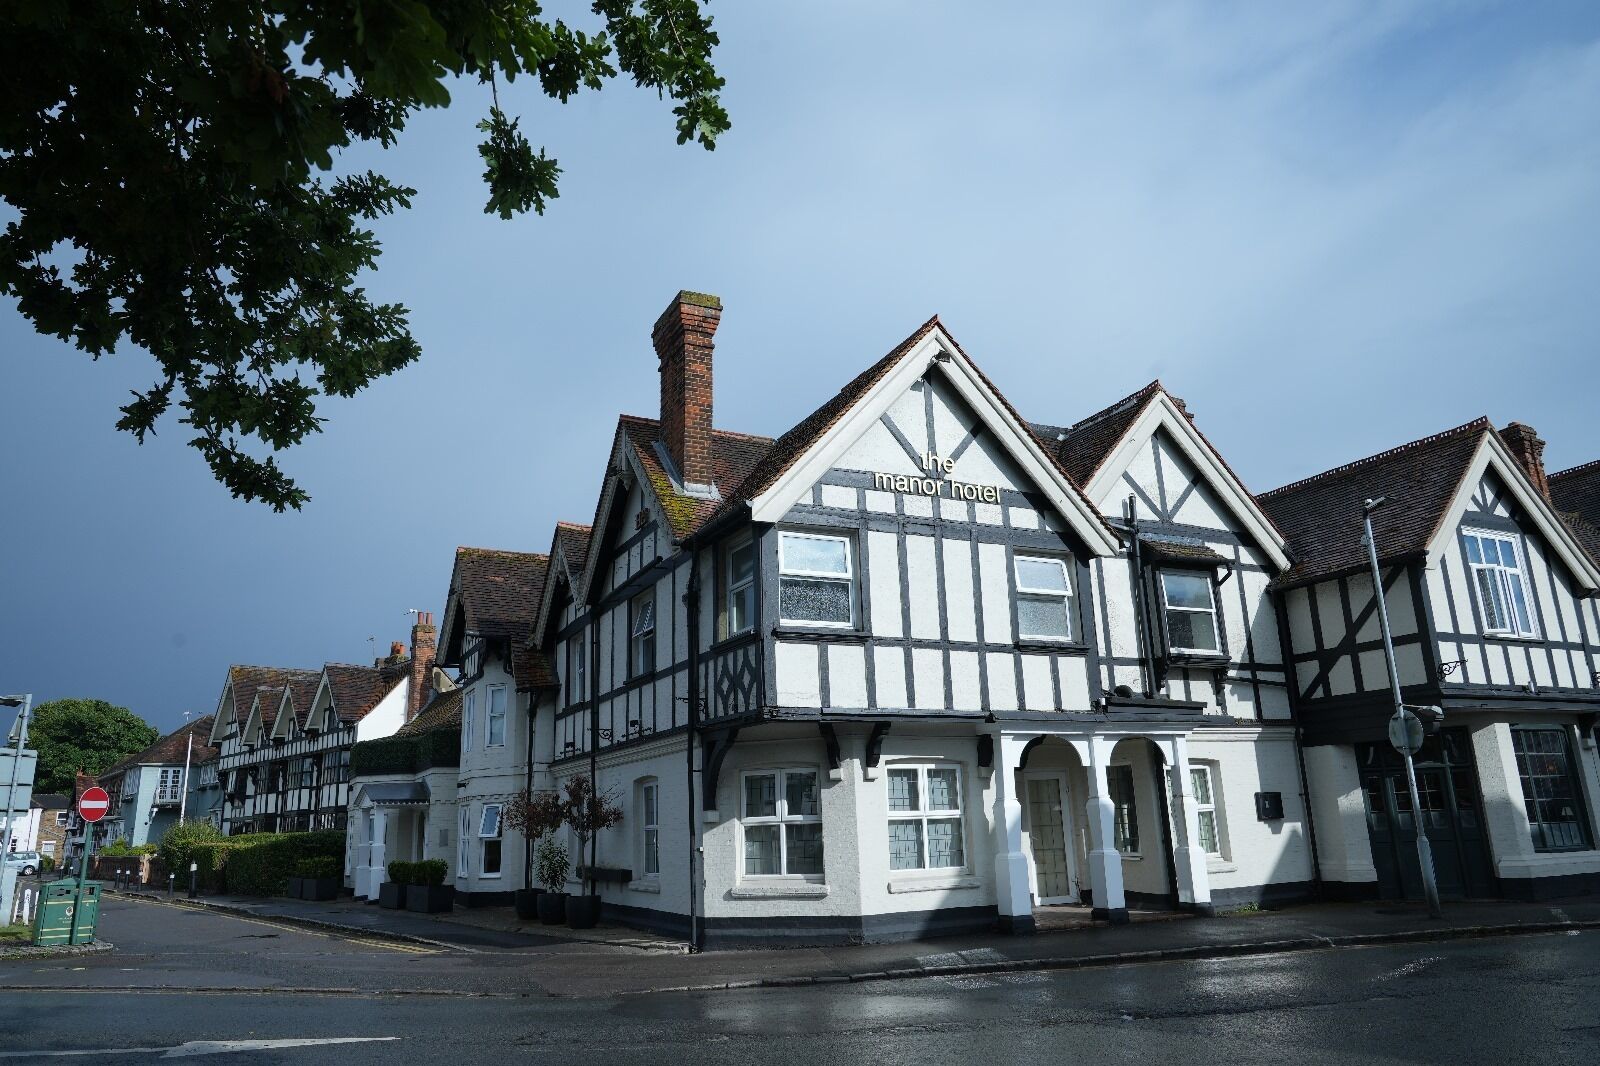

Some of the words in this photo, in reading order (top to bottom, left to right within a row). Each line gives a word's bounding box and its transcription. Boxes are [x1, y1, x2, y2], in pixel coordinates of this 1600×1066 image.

[920, 451, 955, 473] the
[874, 472, 944, 496] manor
[951, 480, 1001, 503] hotel
